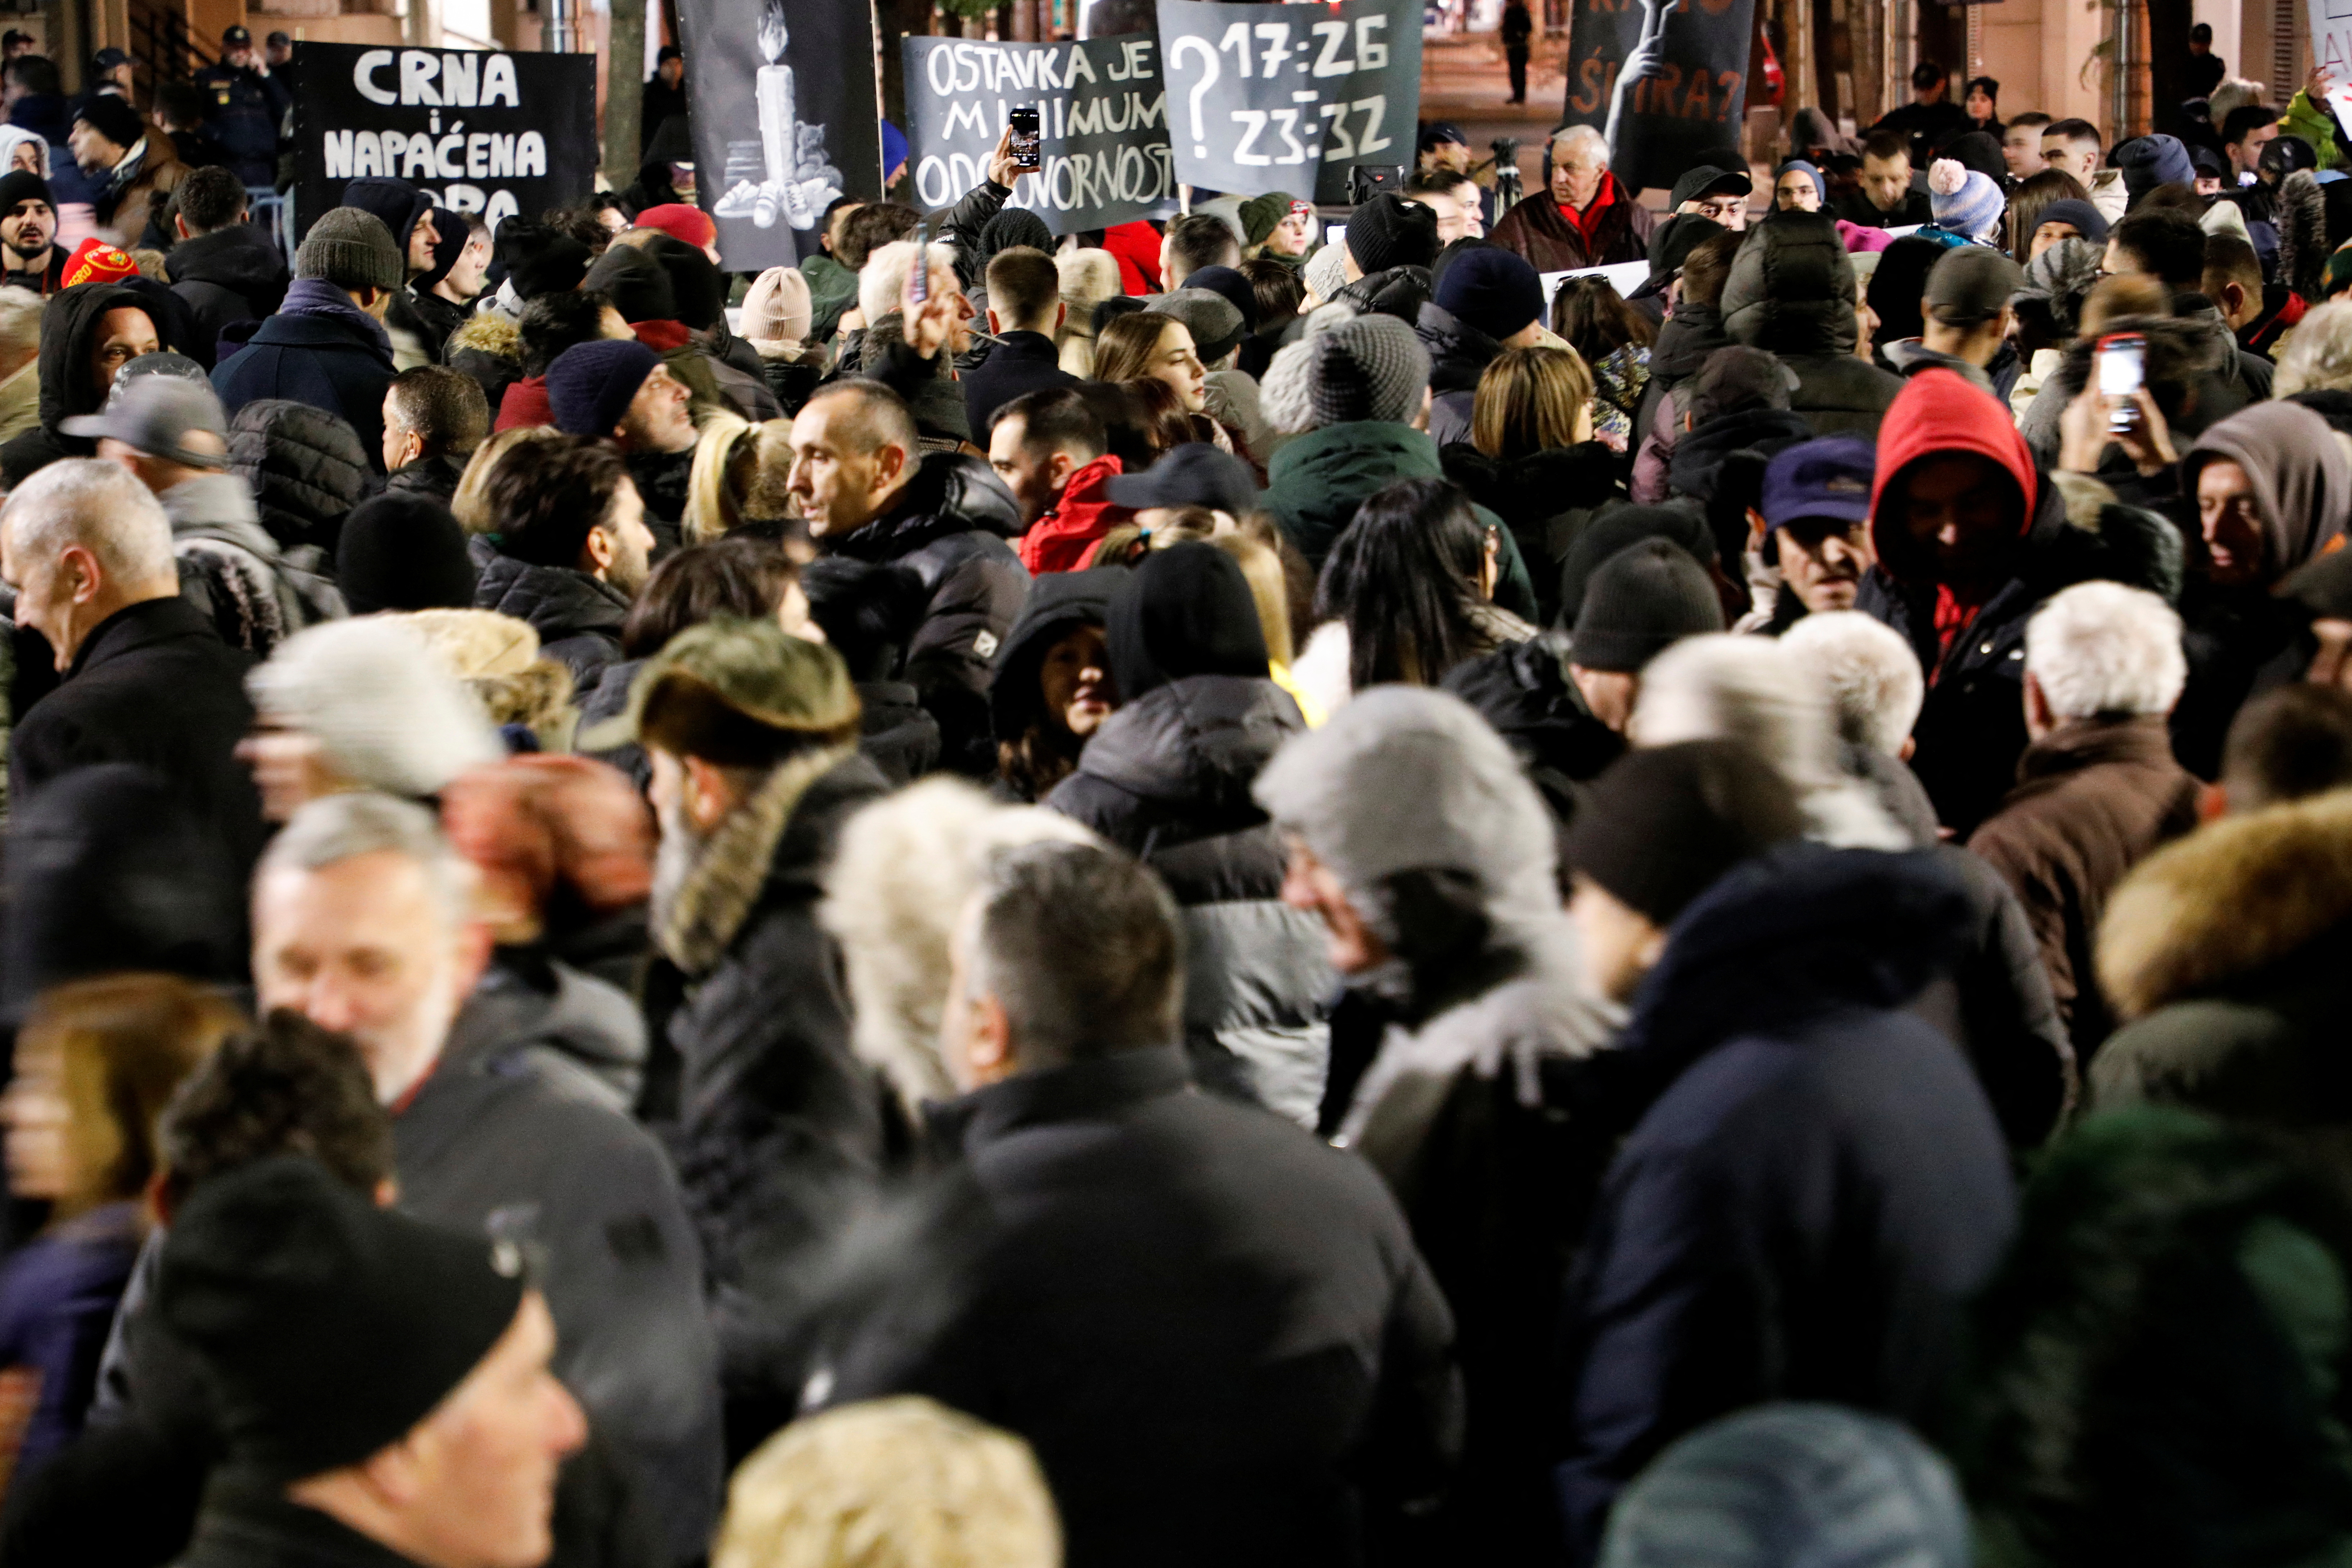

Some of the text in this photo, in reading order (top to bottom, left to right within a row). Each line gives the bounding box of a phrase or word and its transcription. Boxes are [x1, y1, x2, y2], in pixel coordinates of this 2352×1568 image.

[354, 49, 519, 107] CRNA
[927, 41, 1154, 96] OSTAVKA JE
[325, 120, 547, 179] NAPAĆENA
[429, 109, 440, 135] i
